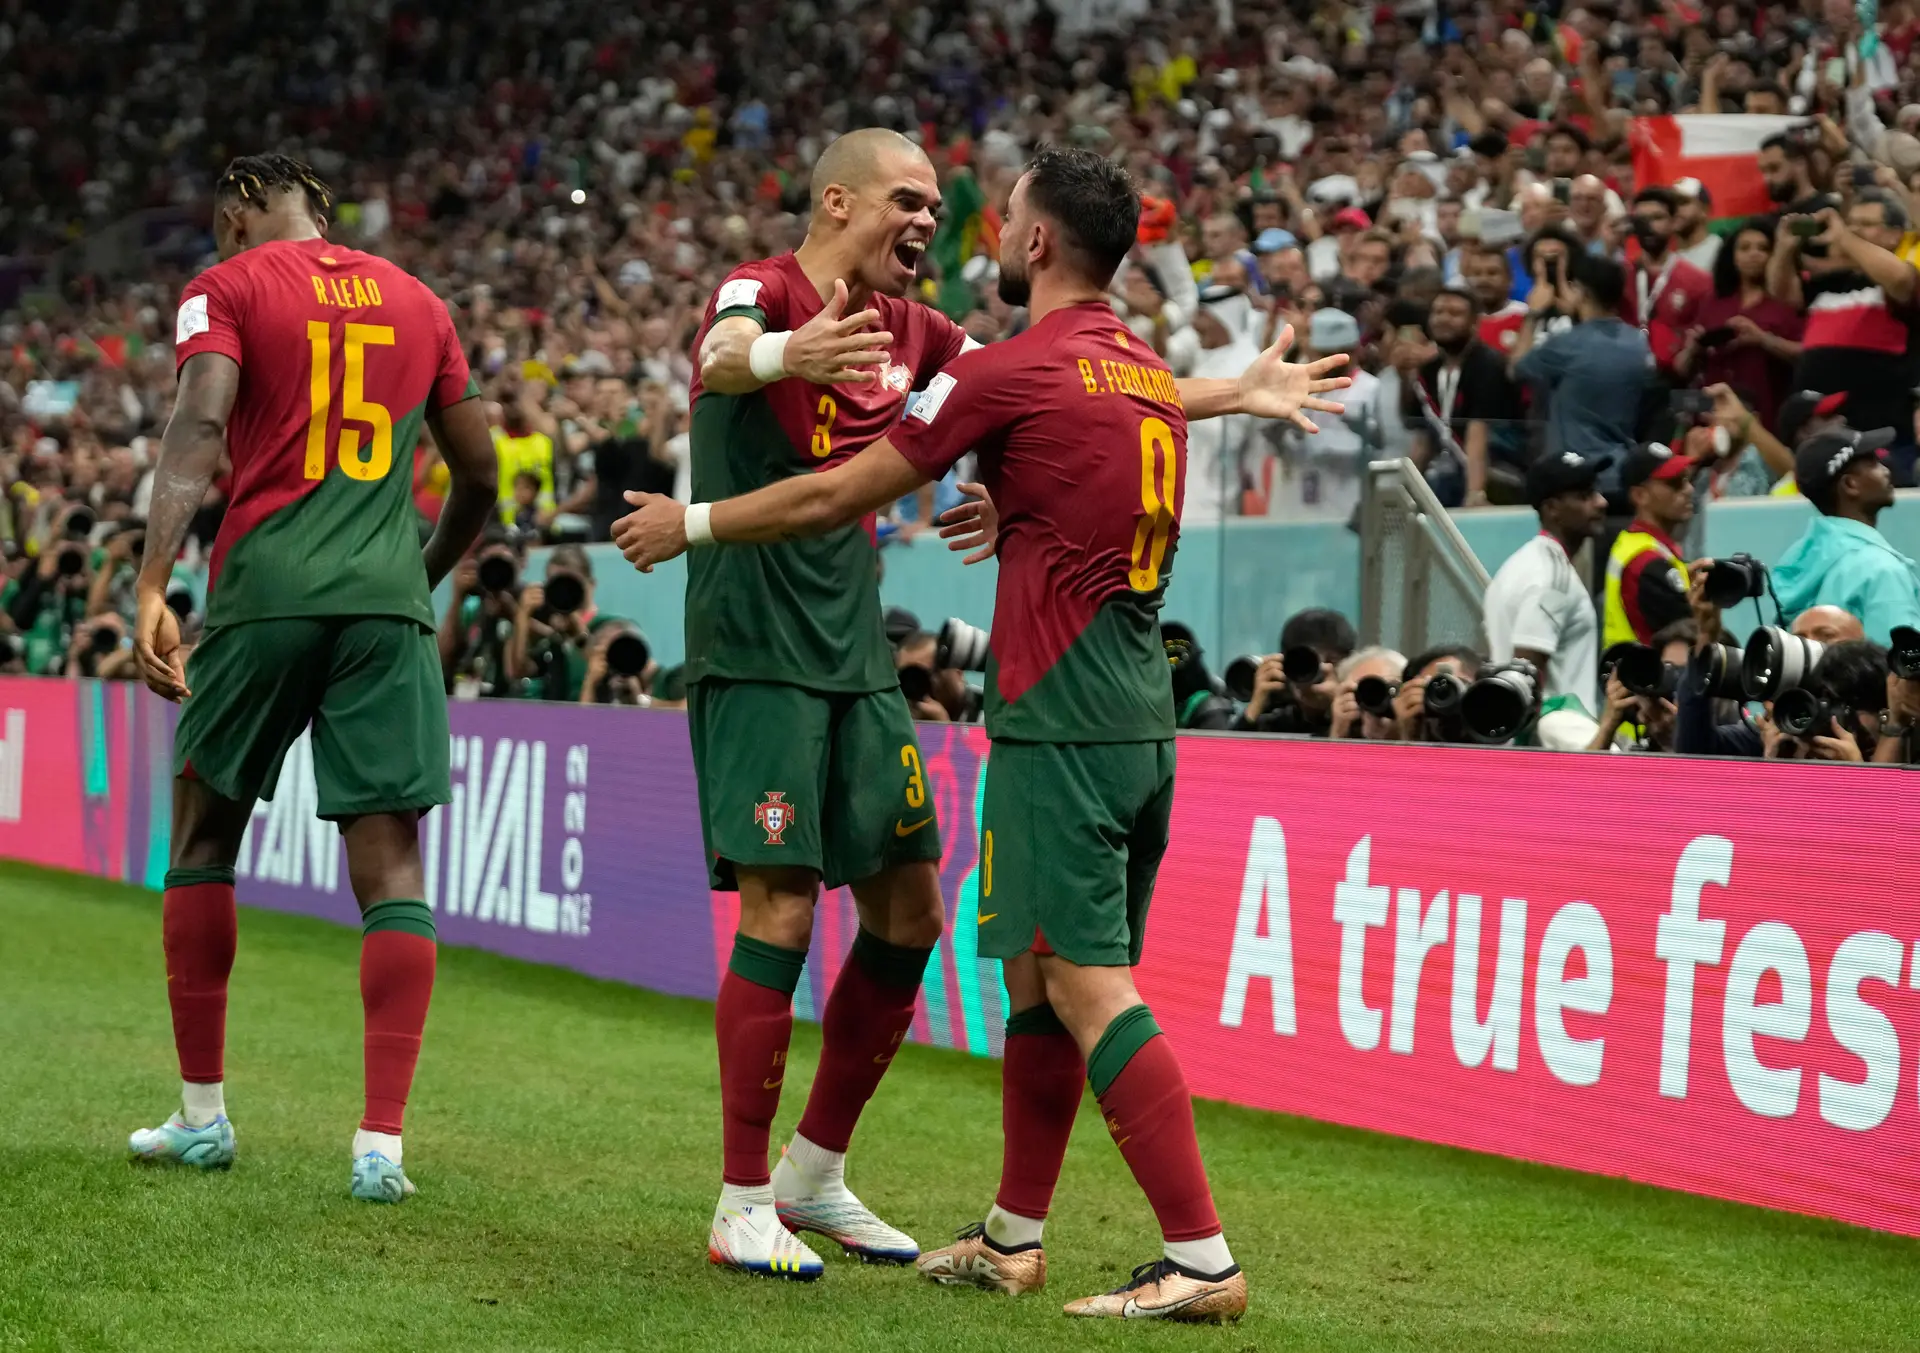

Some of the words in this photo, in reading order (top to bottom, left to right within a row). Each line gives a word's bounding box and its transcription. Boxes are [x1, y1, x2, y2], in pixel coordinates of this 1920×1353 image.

[311, 275, 383, 308] R.LEÃO
[304, 320, 395, 481] 15
[811, 394, 837, 458] 3
[1128, 417, 1176, 592] 8
[901, 745, 925, 808] 3
[984, 830, 993, 897] 8
[1219, 816, 1297, 1037] A
[1333, 834, 1613, 1087] true
